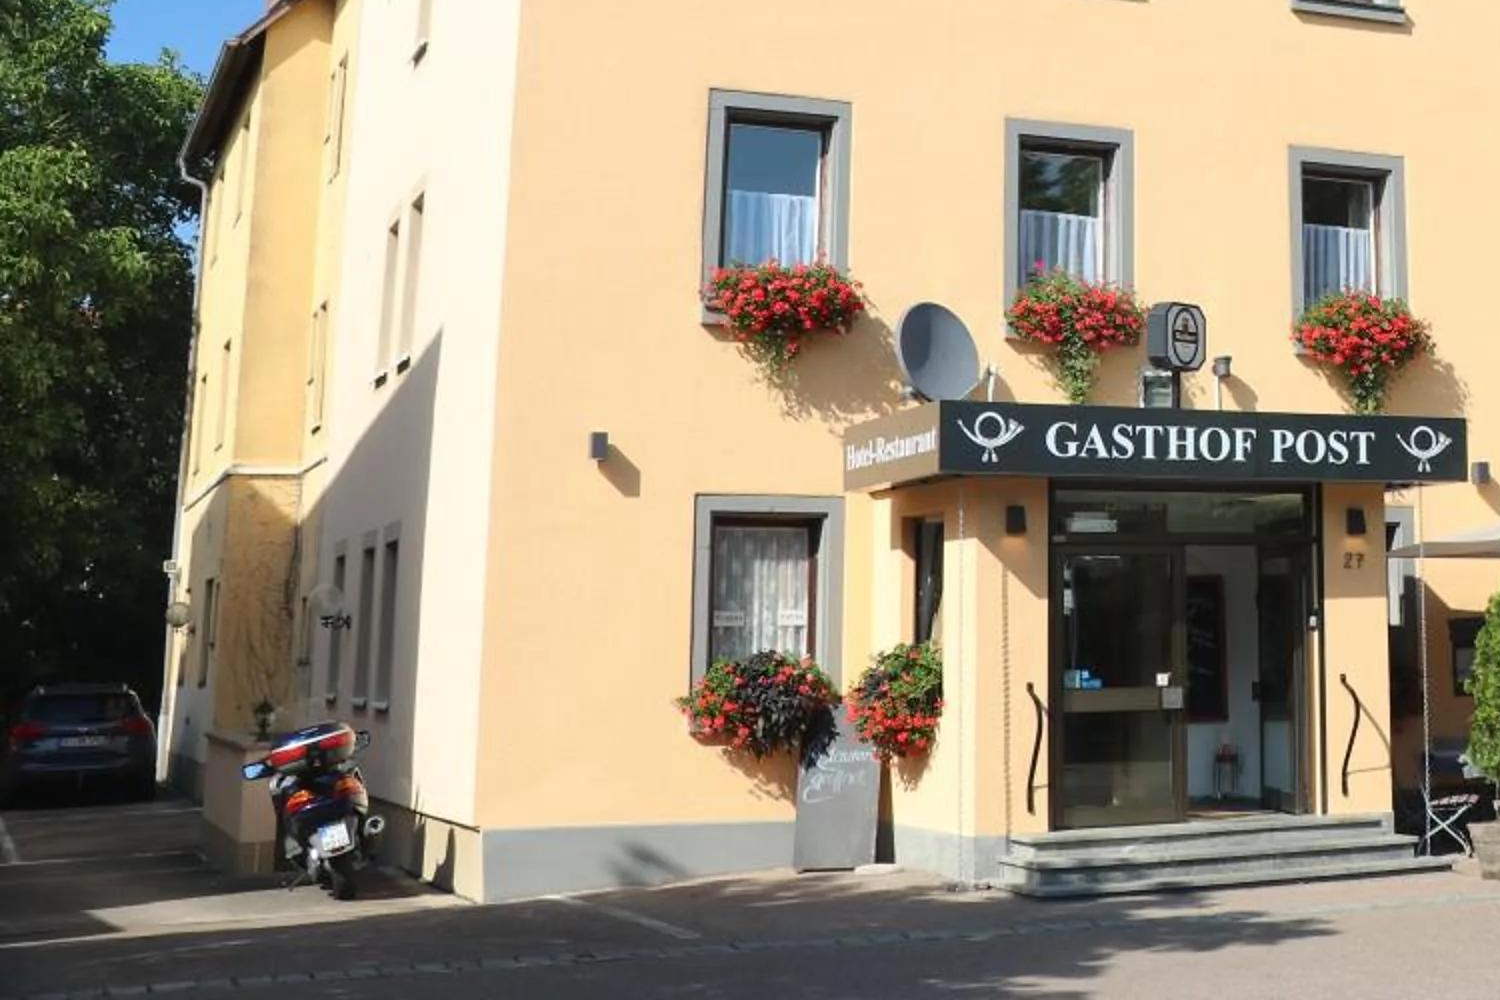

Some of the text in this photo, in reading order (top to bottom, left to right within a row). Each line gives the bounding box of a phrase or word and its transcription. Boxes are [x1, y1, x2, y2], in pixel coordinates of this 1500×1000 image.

[845, 427, 936, 471] Hotel-Restaurant
[1045, 421, 1375, 465] GASTHOF POST
[1343, 552, 1365, 569] 27
